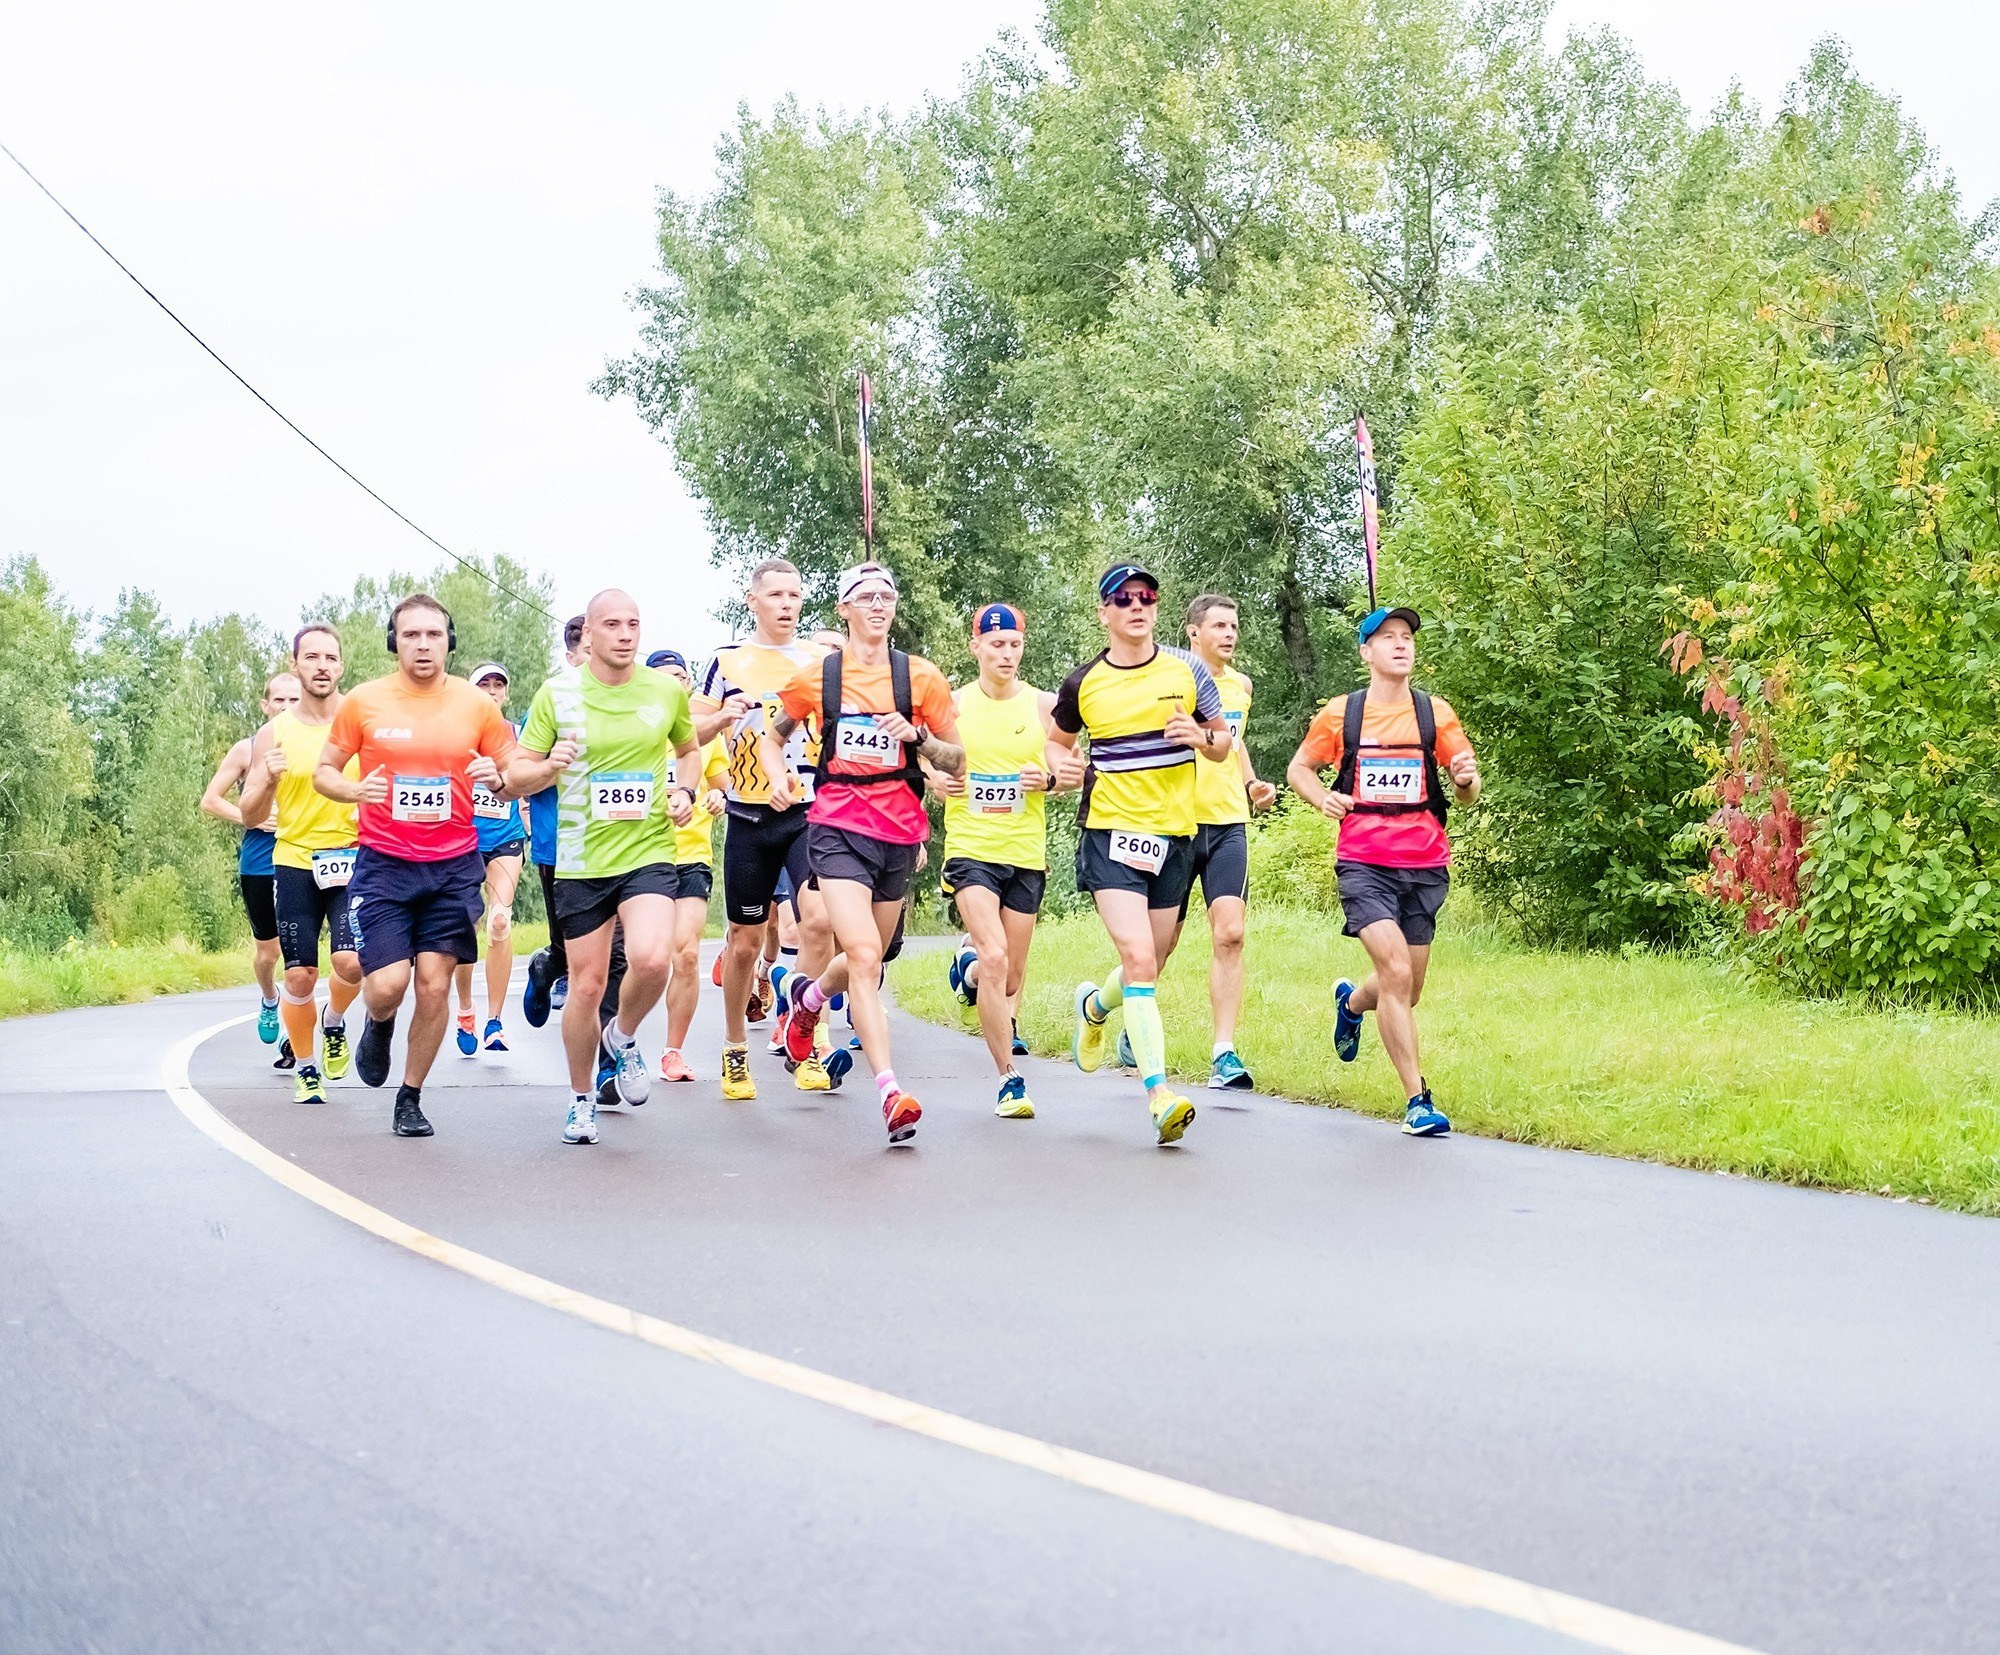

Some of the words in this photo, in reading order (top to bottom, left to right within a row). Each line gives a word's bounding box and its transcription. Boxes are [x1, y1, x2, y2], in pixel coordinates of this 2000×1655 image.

[843, 730, 889, 750] 2443
[1366, 773, 1412, 788] 2447
[399, 791, 444, 807] 2545
[598, 788, 646, 804] 2869
[975, 787, 1016, 801] 2673
[1117, 836, 1160, 858] 2600
